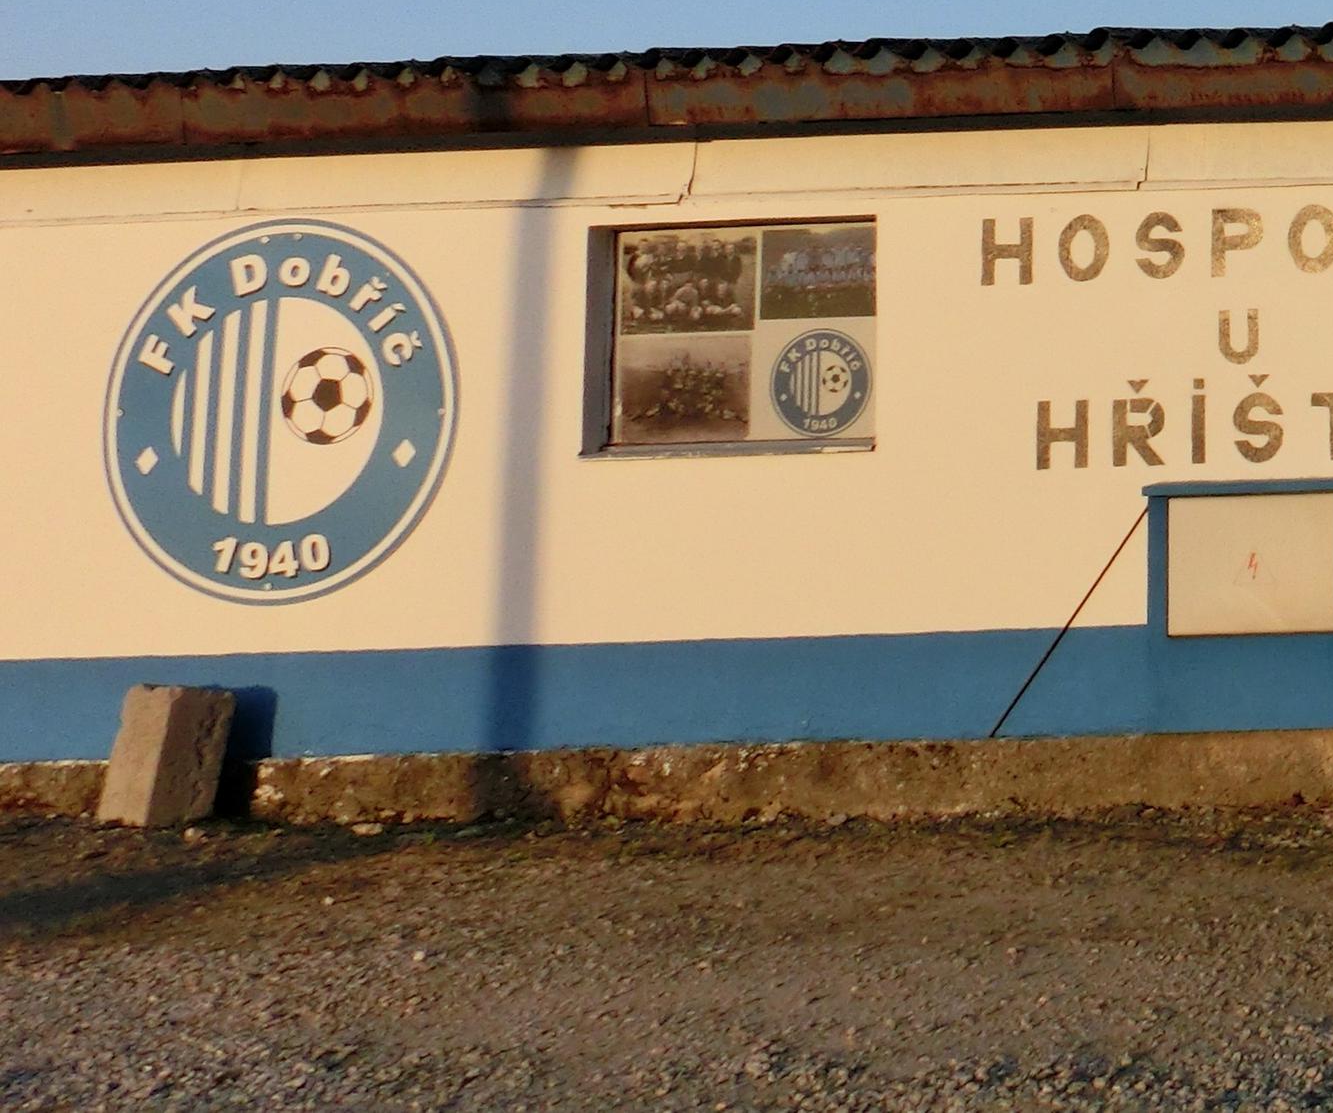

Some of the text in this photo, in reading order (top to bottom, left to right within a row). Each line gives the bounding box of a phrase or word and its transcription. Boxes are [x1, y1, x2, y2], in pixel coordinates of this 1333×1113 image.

[138, 253, 423, 376] FK Dobříč
[1218, 308, 1259, 365] U
[803, 416, 838, 431] 1940
[212, 533, 330, 579] 1940
